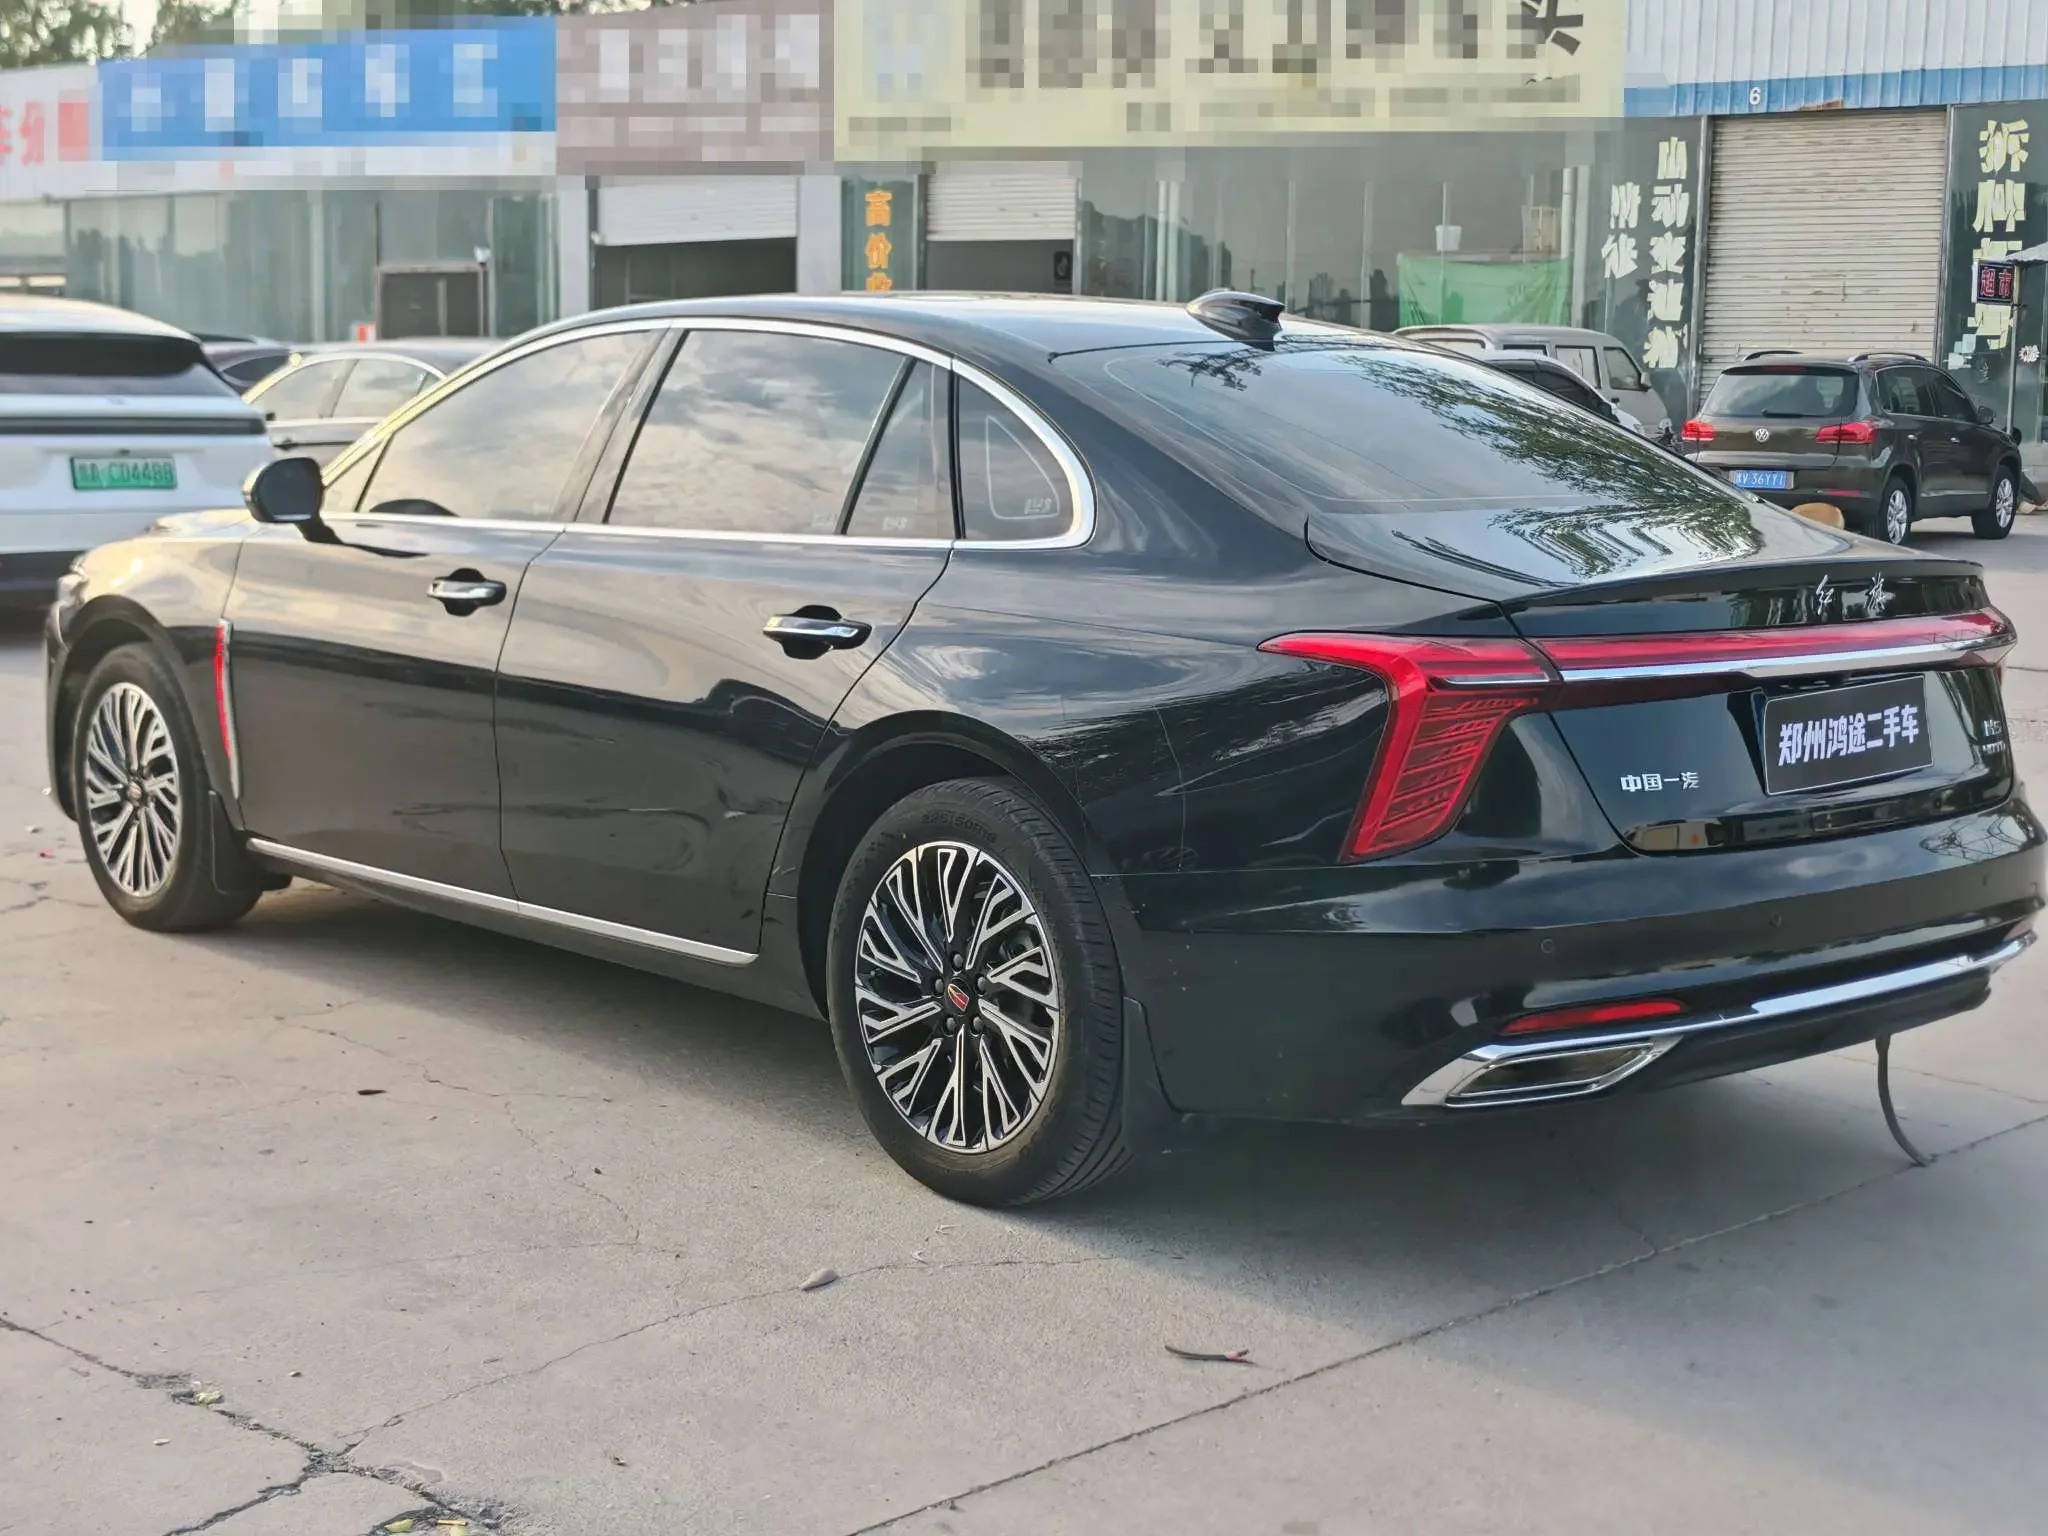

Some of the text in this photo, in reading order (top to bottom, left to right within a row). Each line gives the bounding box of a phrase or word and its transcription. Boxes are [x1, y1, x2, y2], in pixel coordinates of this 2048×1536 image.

[1750, 86, 1761, 106] 6
[1980, 267, 2012, 297] 超市
[1778, 704, 1919, 766] 郑州鸿途二手车
[1620, 771, 1700, 792] 中国一汽
